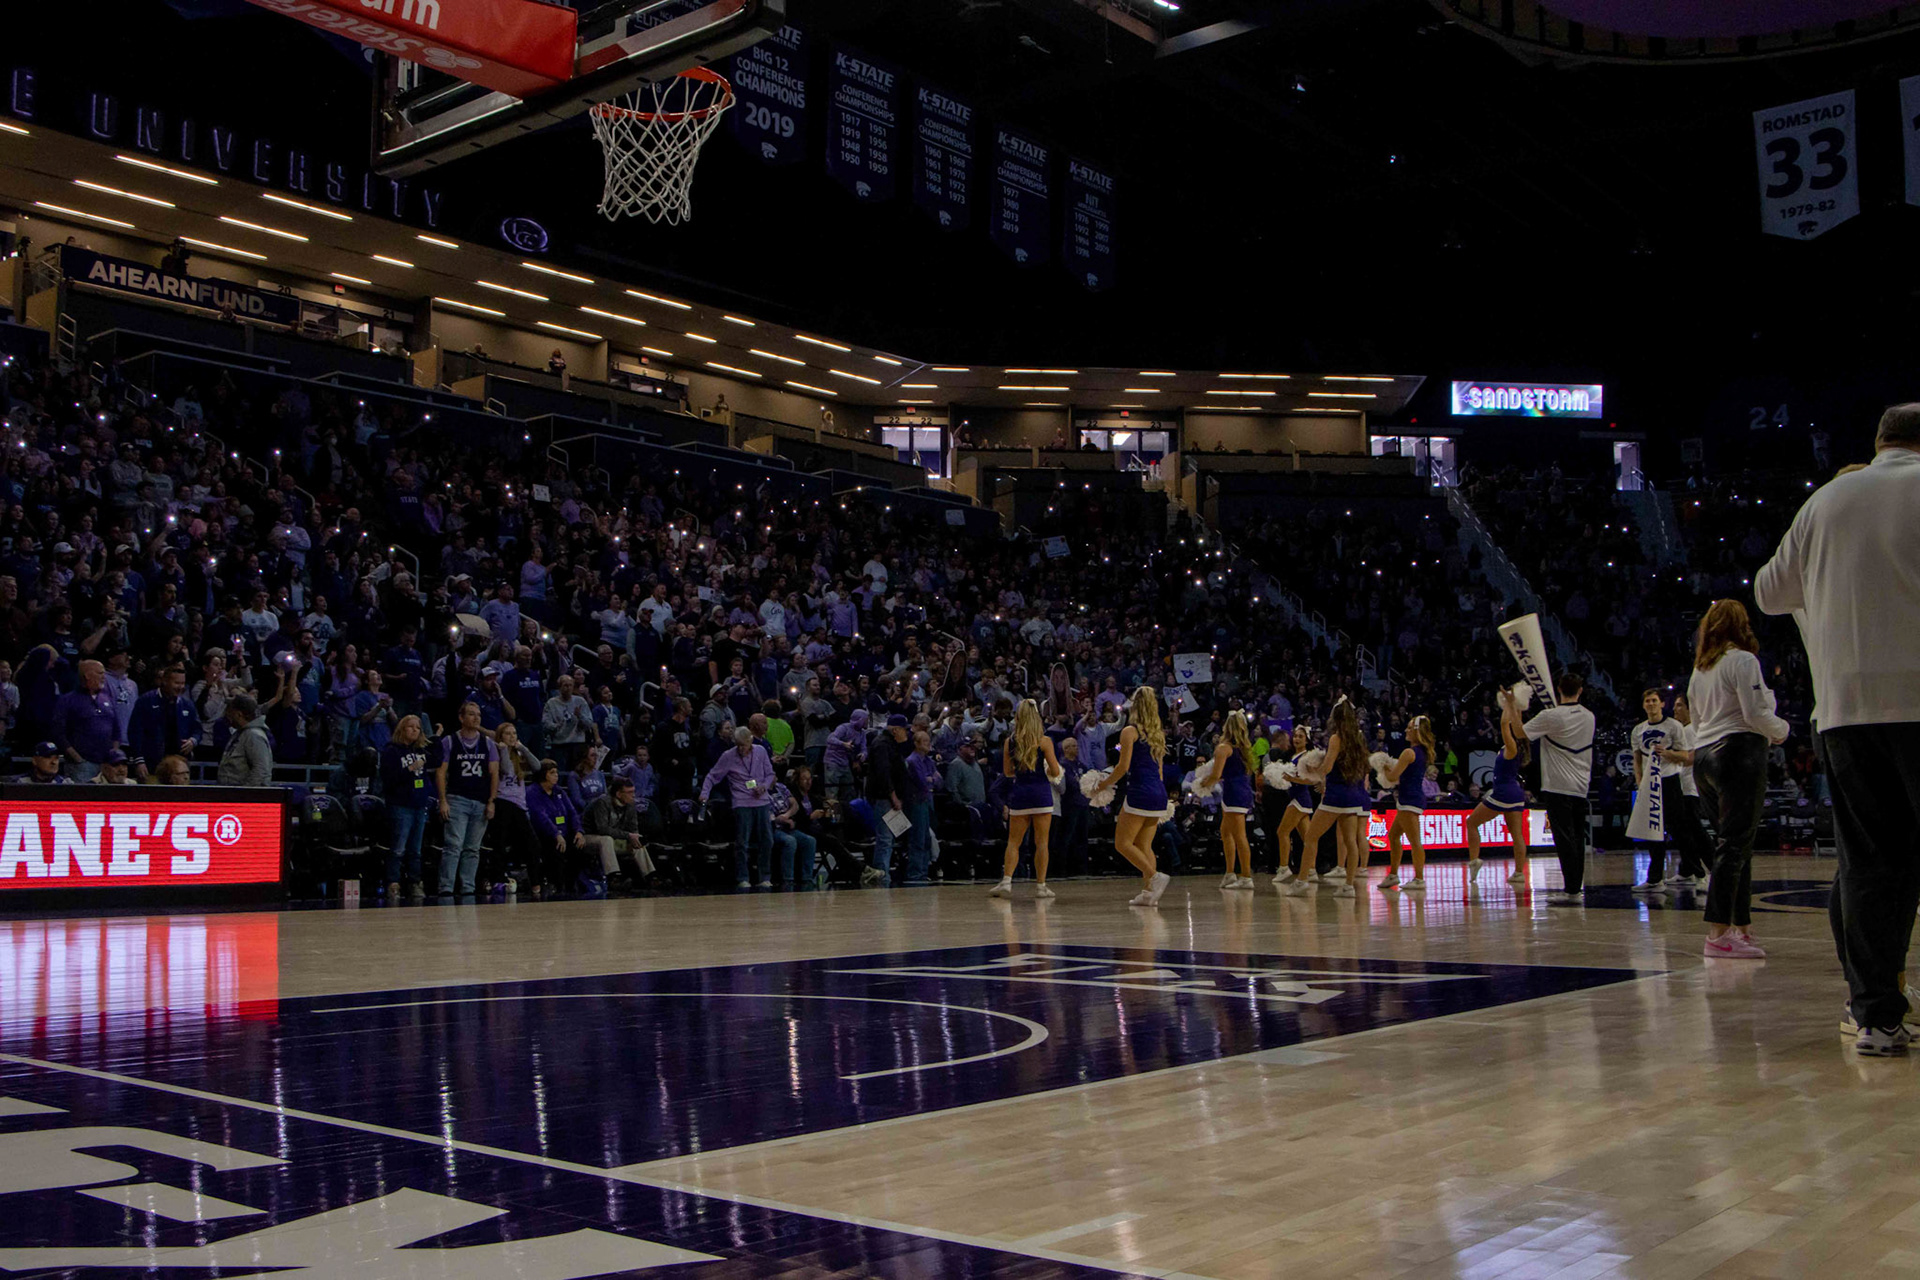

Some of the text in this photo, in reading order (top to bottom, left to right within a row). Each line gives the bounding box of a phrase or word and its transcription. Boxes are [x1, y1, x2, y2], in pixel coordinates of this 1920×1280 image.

[753, 45, 789, 72] BIG 12
[835, 52, 895, 88] K-STATE
[737, 56, 805, 92] CONFERENCE
[735, 69, 806, 109] CHAMPIONS
[842, 84, 888, 109] CONFERENCE
[835, 91, 895, 122] CHAMPIONSHIPS
[918, 87, 973, 120] K-STATE
[745, 101, 795, 138] 2019
[841, 112, 861, 127] 1917
[869, 122, 887, 138] 1951
[924, 117, 966, 142] CONFERENCE
[1763, 104, 1845, 133] ROMSTAD
[841, 125, 861, 140] 1919
[869, 135, 887, 150] 1956
[919, 125, 972, 154] CHAMPIONSHIPS
[92, 93, 441, 227] UNIVERSITY
[998, 131, 1047, 162] K-STATE
[868, 160, 888, 175] 1959
[1004, 160, 1043, 182] CONFERENCE
[1069, 161, 1113, 190] K-STATE
[1766, 127, 1847, 198] 33
[997, 166, 1048, 194] CHAMPIONSHIPS
[1780, 200, 1836, 219] 1979-82
[278, 285, 291, 296] 20
[1469, 386, 1590, 411] SANDSTORM
[1749, 403, 1790, 430] 24
[461, 761, 483, 778] 24
[1649, 769, 1662, 831] K-STATE
